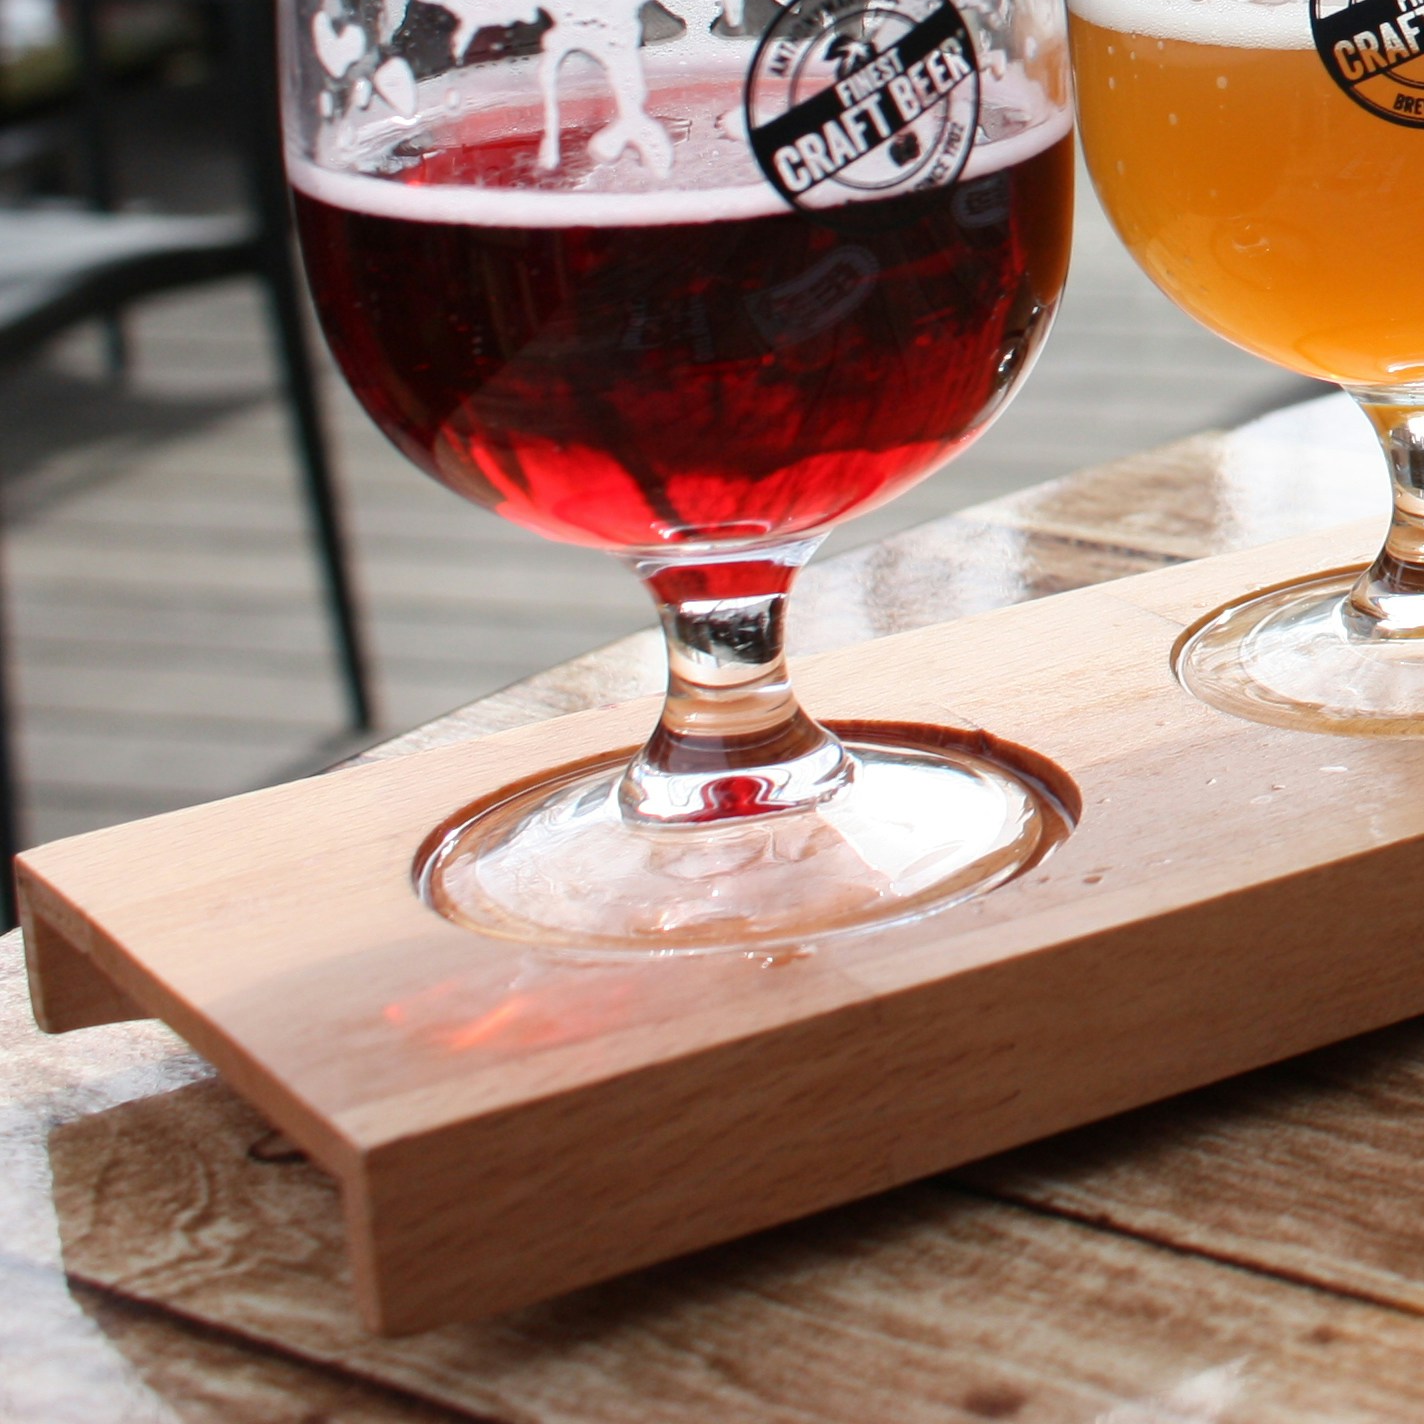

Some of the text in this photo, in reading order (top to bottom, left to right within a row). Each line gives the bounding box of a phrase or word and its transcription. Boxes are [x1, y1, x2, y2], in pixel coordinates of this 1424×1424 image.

[773, 36, 972, 193] CRAFT BEER
[834, 47, 905, 108] FINEST
